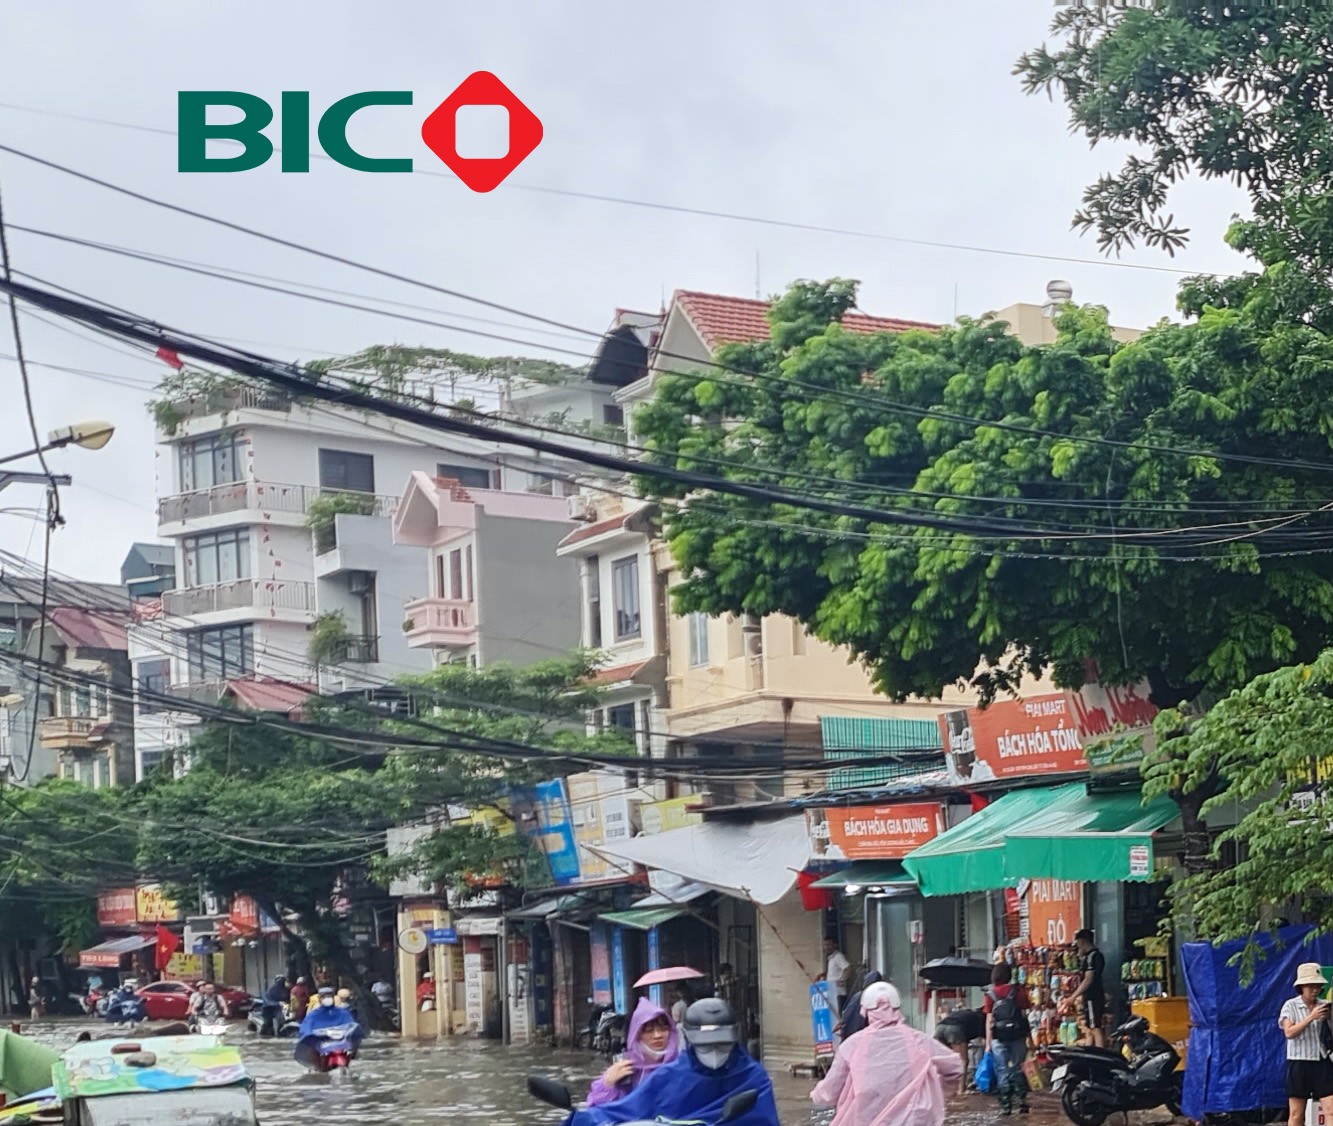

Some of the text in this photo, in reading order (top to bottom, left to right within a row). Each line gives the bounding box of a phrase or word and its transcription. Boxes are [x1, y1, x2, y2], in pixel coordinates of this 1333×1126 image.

[1044, 699, 1066, 715] MART
[996, 727, 1026, 758] BÁCH
[1026, 725, 1051, 754] HÓA
[844, 816, 868, 837] BÁCH
[868, 815, 887, 836] HÓA
[886, 819, 903, 834] GIA
[903, 816, 929, 838] DỤNG
